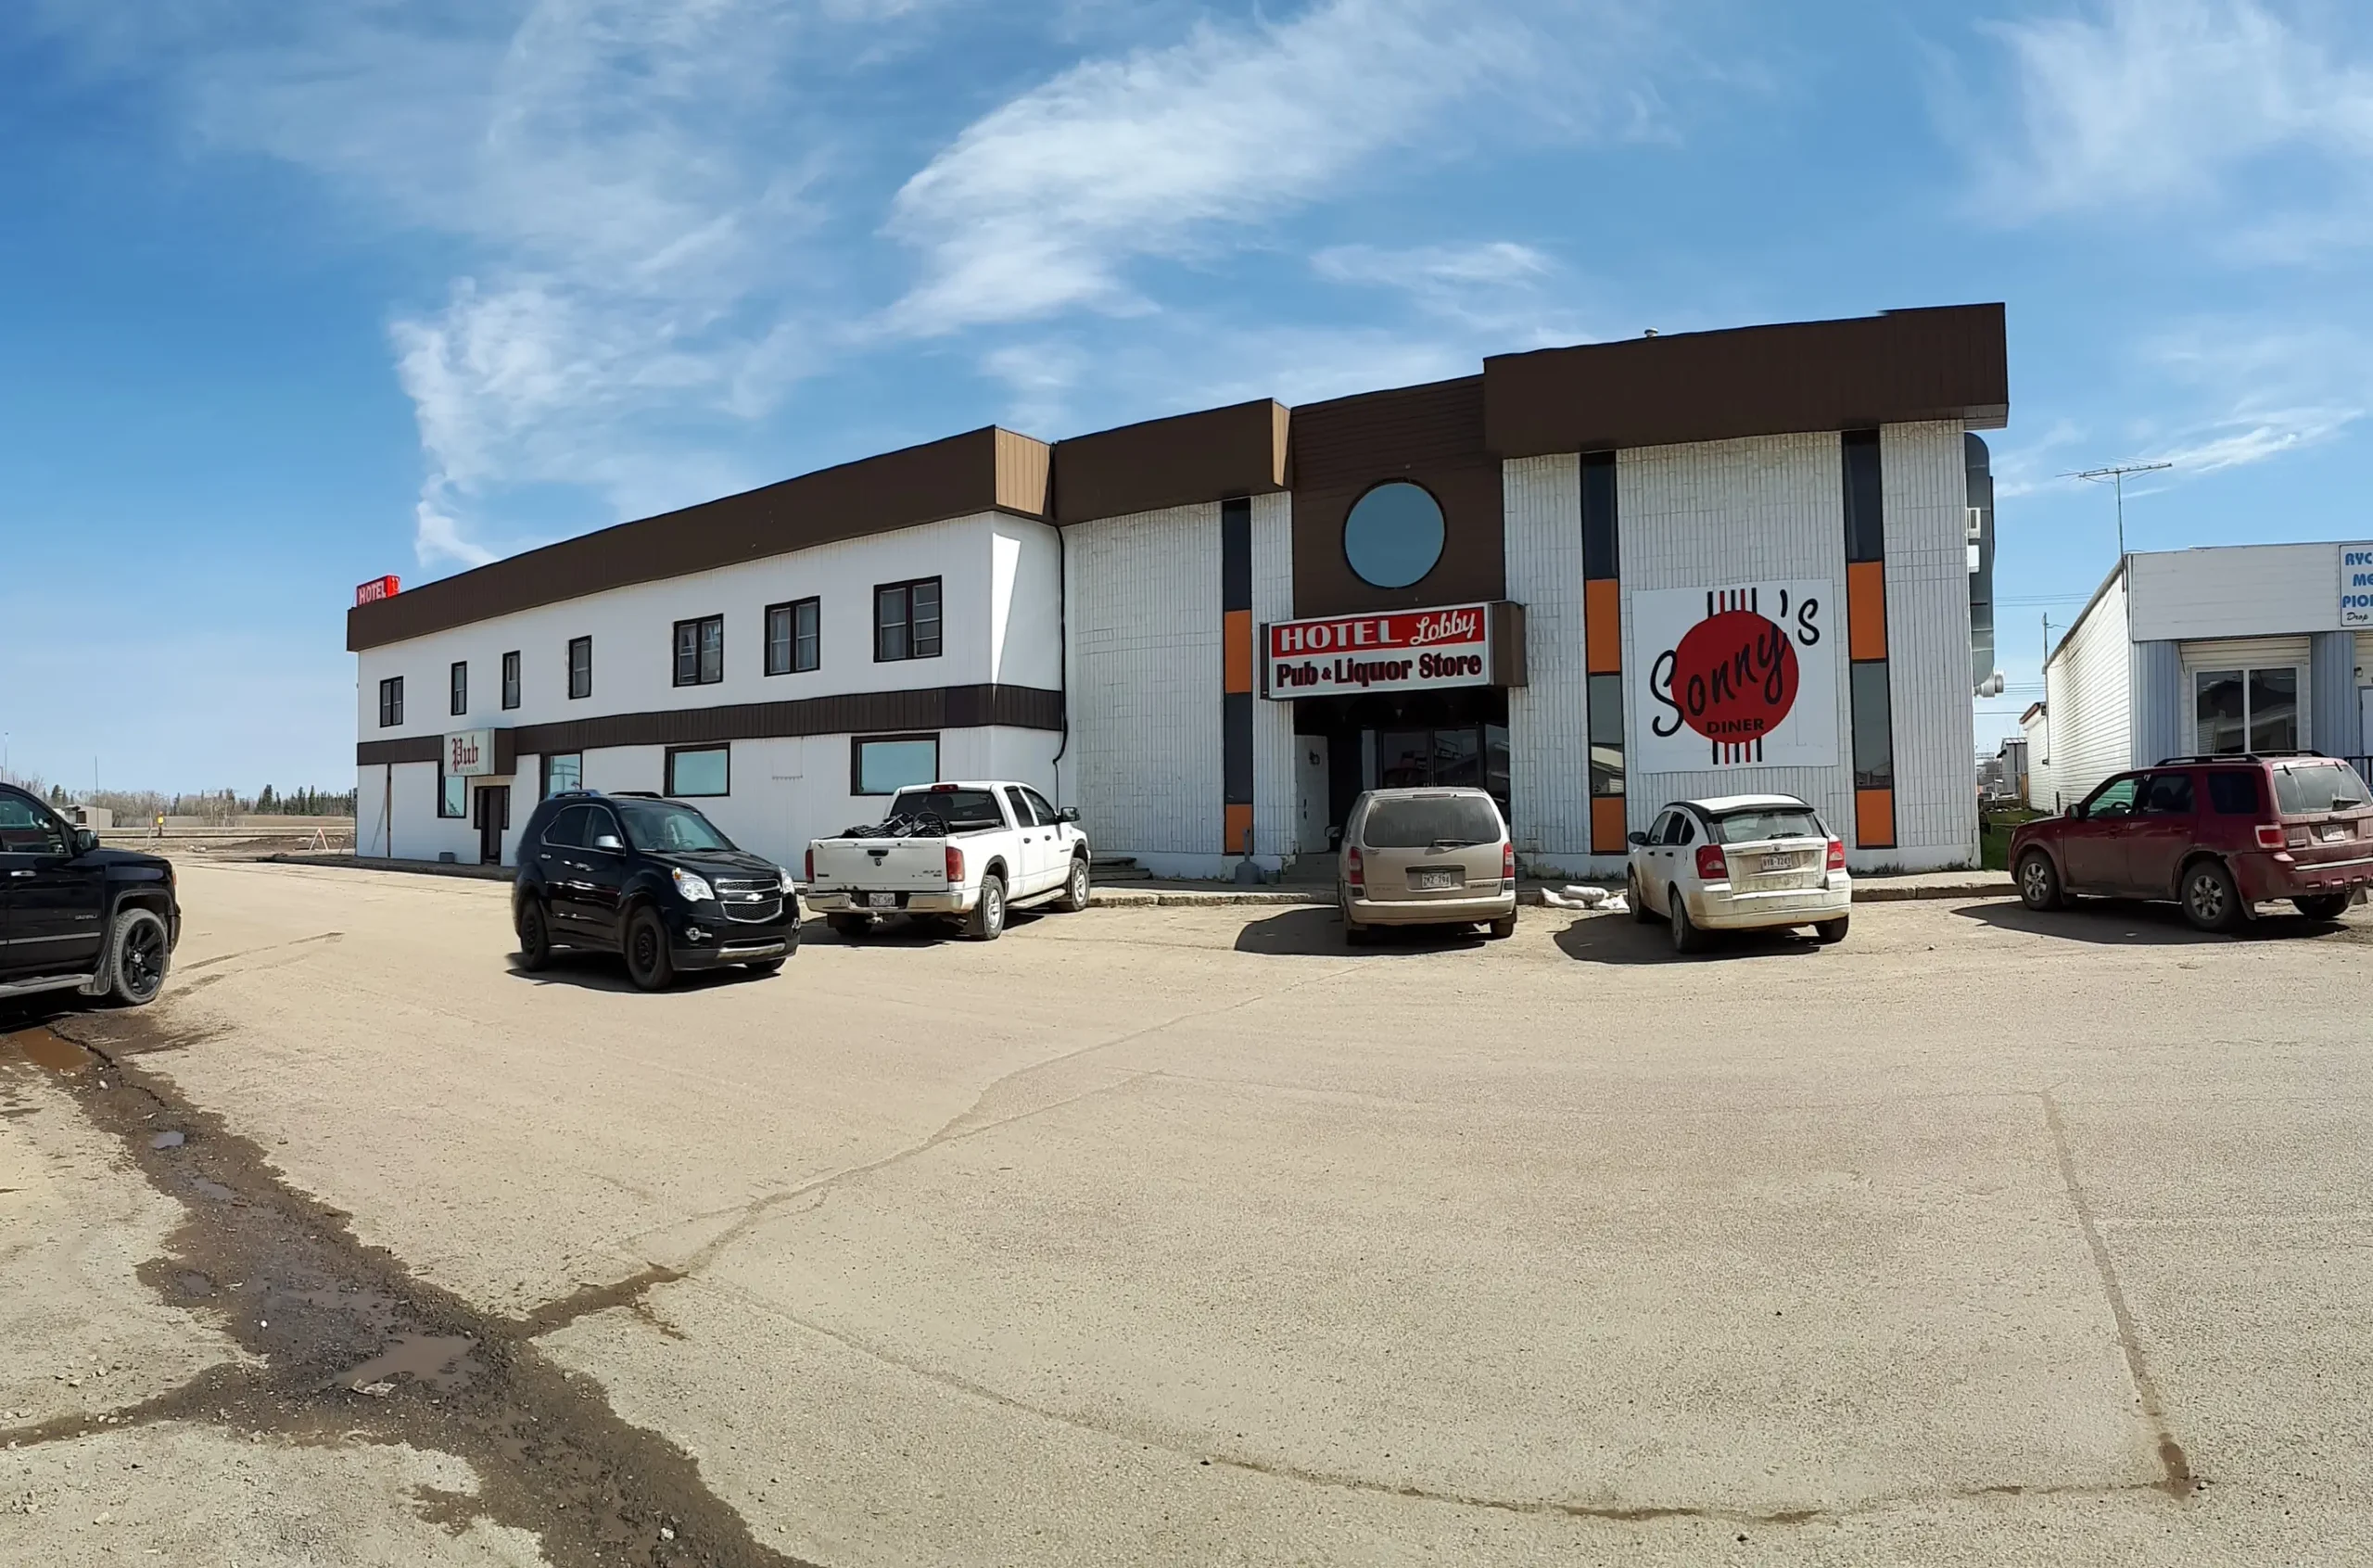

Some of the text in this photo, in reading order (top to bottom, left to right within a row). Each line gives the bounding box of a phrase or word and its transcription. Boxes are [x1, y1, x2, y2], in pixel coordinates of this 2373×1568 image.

[358, 580, 387, 605] HOTEL
[1281, 610, 1476, 651] HOTEL Lobby
[2346, 612, 2369, 623] Drop
[1276, 652, 1482, 688] Pub & Liquor Store
[1650, 588, 1820, 737] Sonny's
[1707, 718, 1764, 734] DINER
[451, 734, 479, 773] Pub
